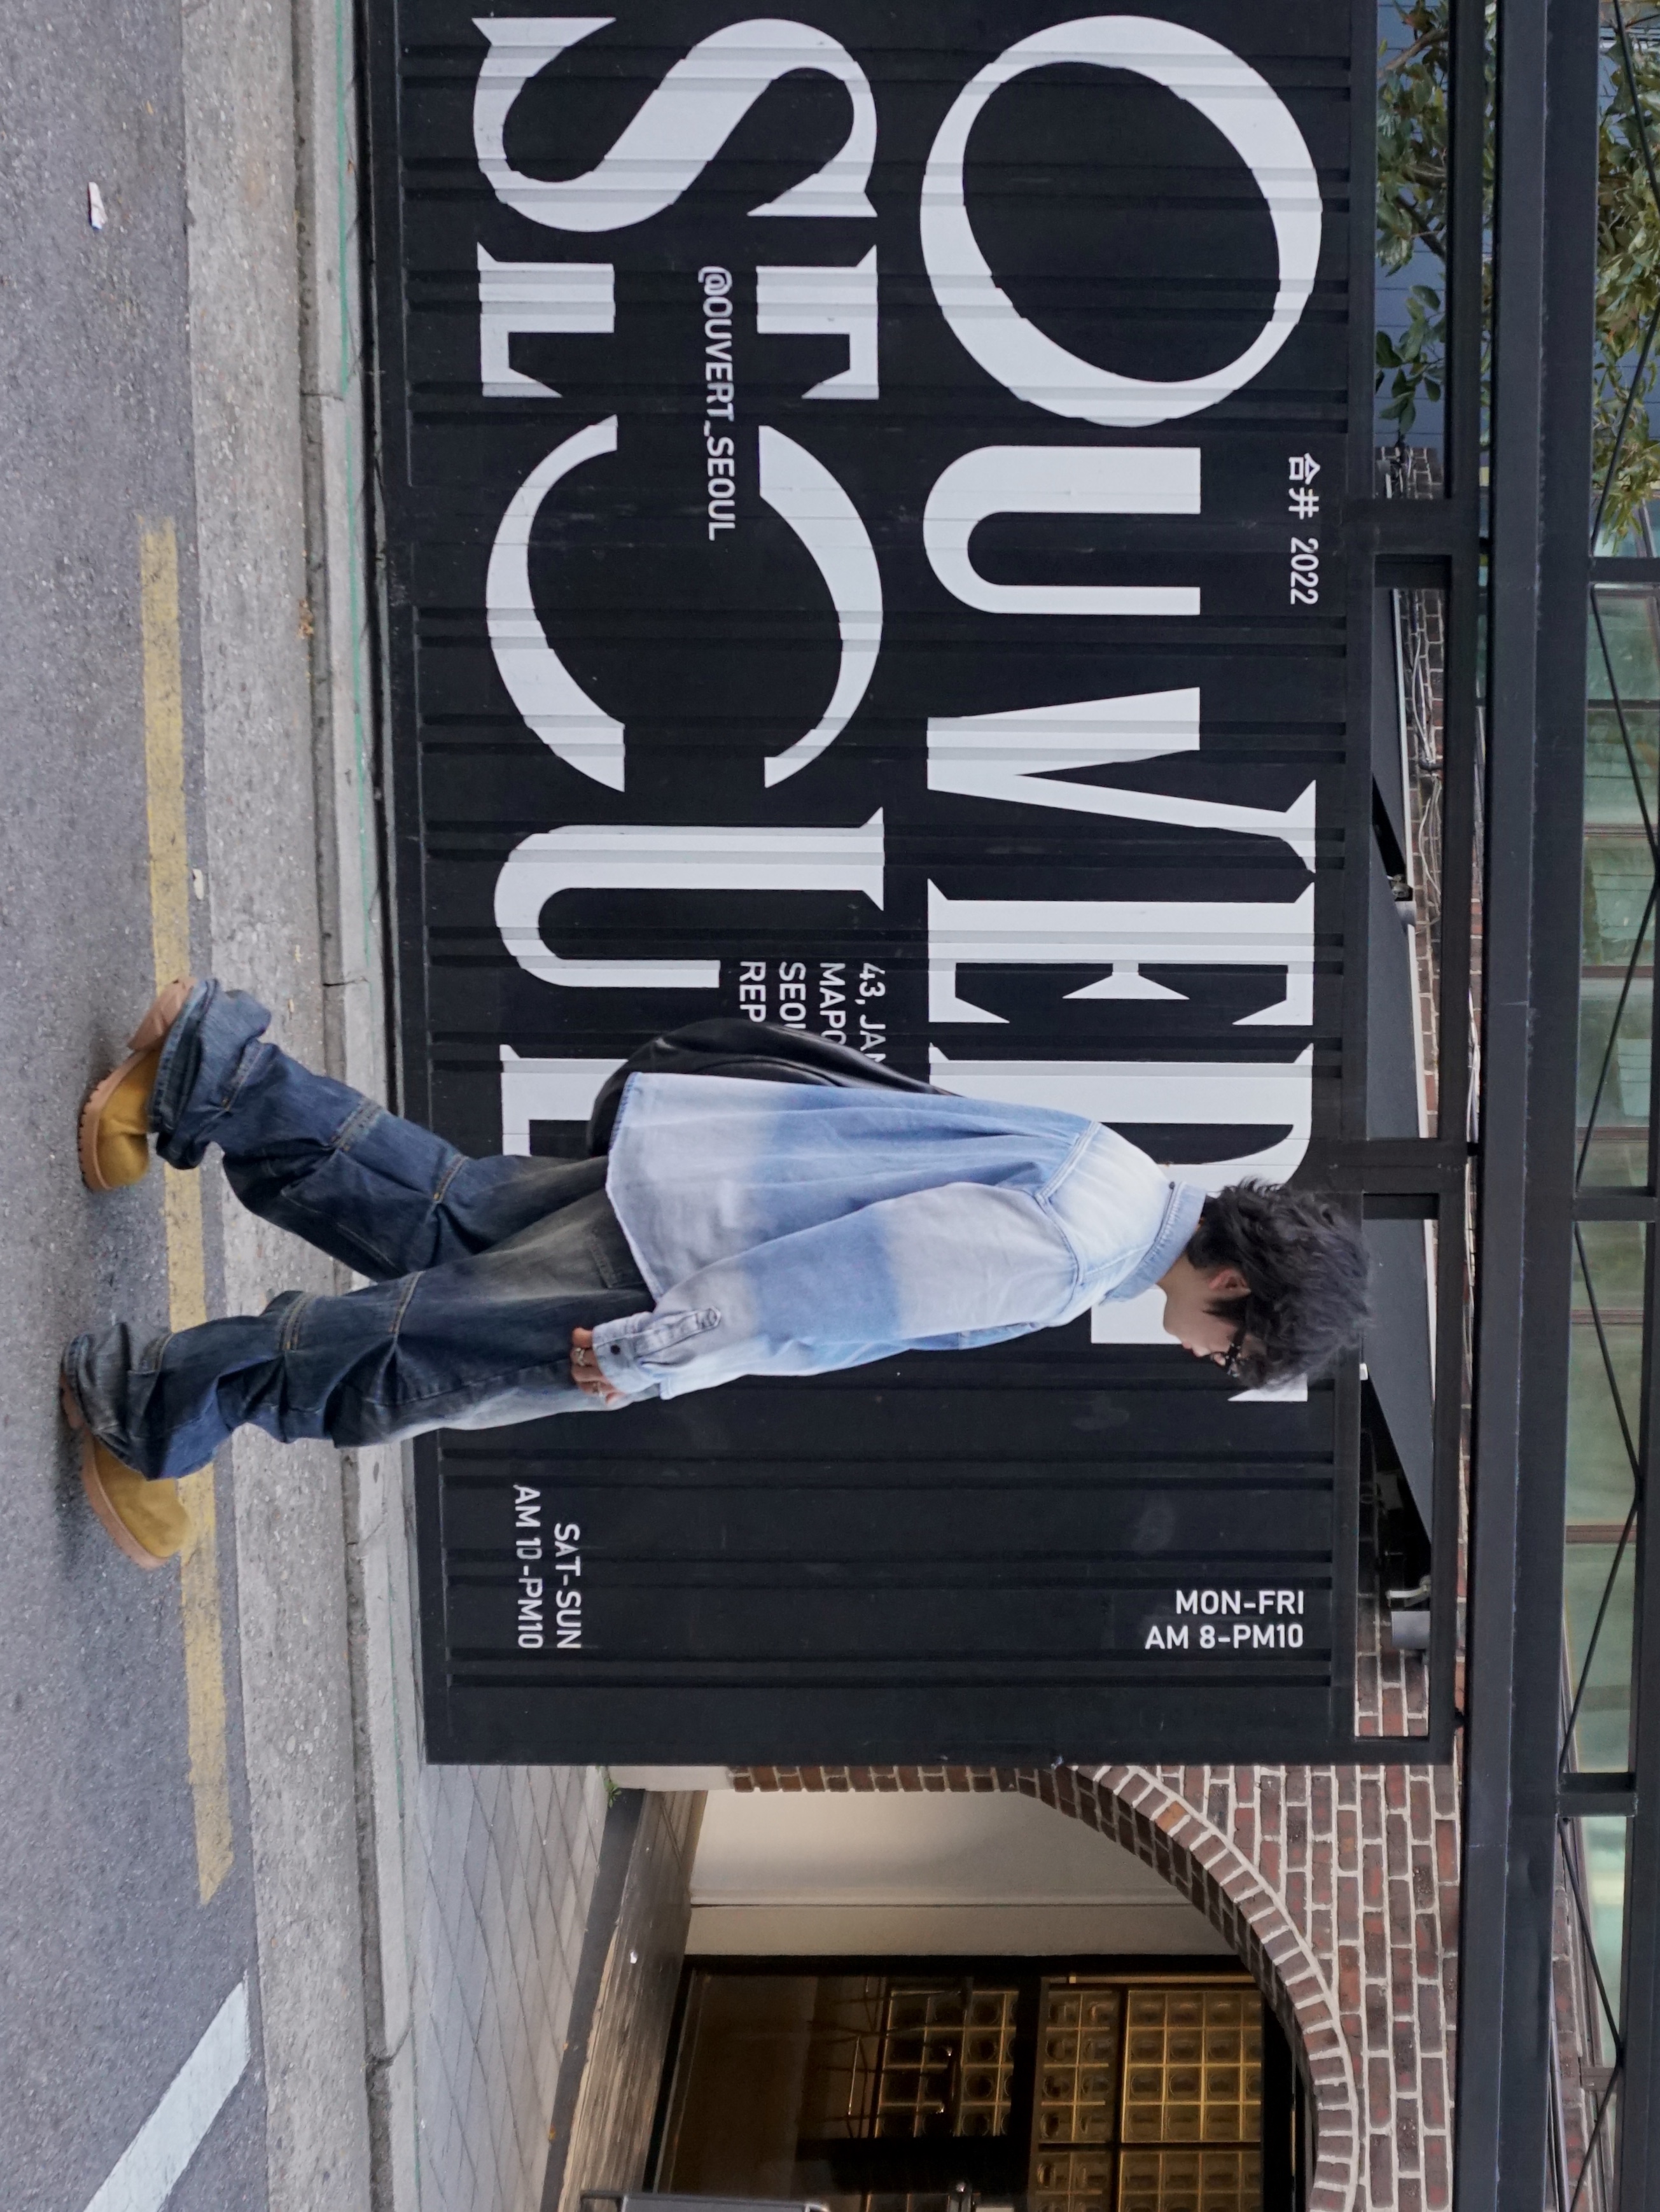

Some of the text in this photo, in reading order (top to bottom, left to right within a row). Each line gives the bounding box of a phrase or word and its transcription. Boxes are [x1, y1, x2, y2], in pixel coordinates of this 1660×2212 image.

[698, 266, 736, 541] @OUVERT_SEOUL
[1288, 452, 1321, 605] 合井 2022
[855, 962, 886, 1005] 43,
[514, 1485, 541, 1527] AM
[554, 1523, 582, 1649] SAT-SUN
[1176, 1590, 1304, 1615] MON-FRI
[1145, 1623, 1304, 1649] AM 8-PM10
